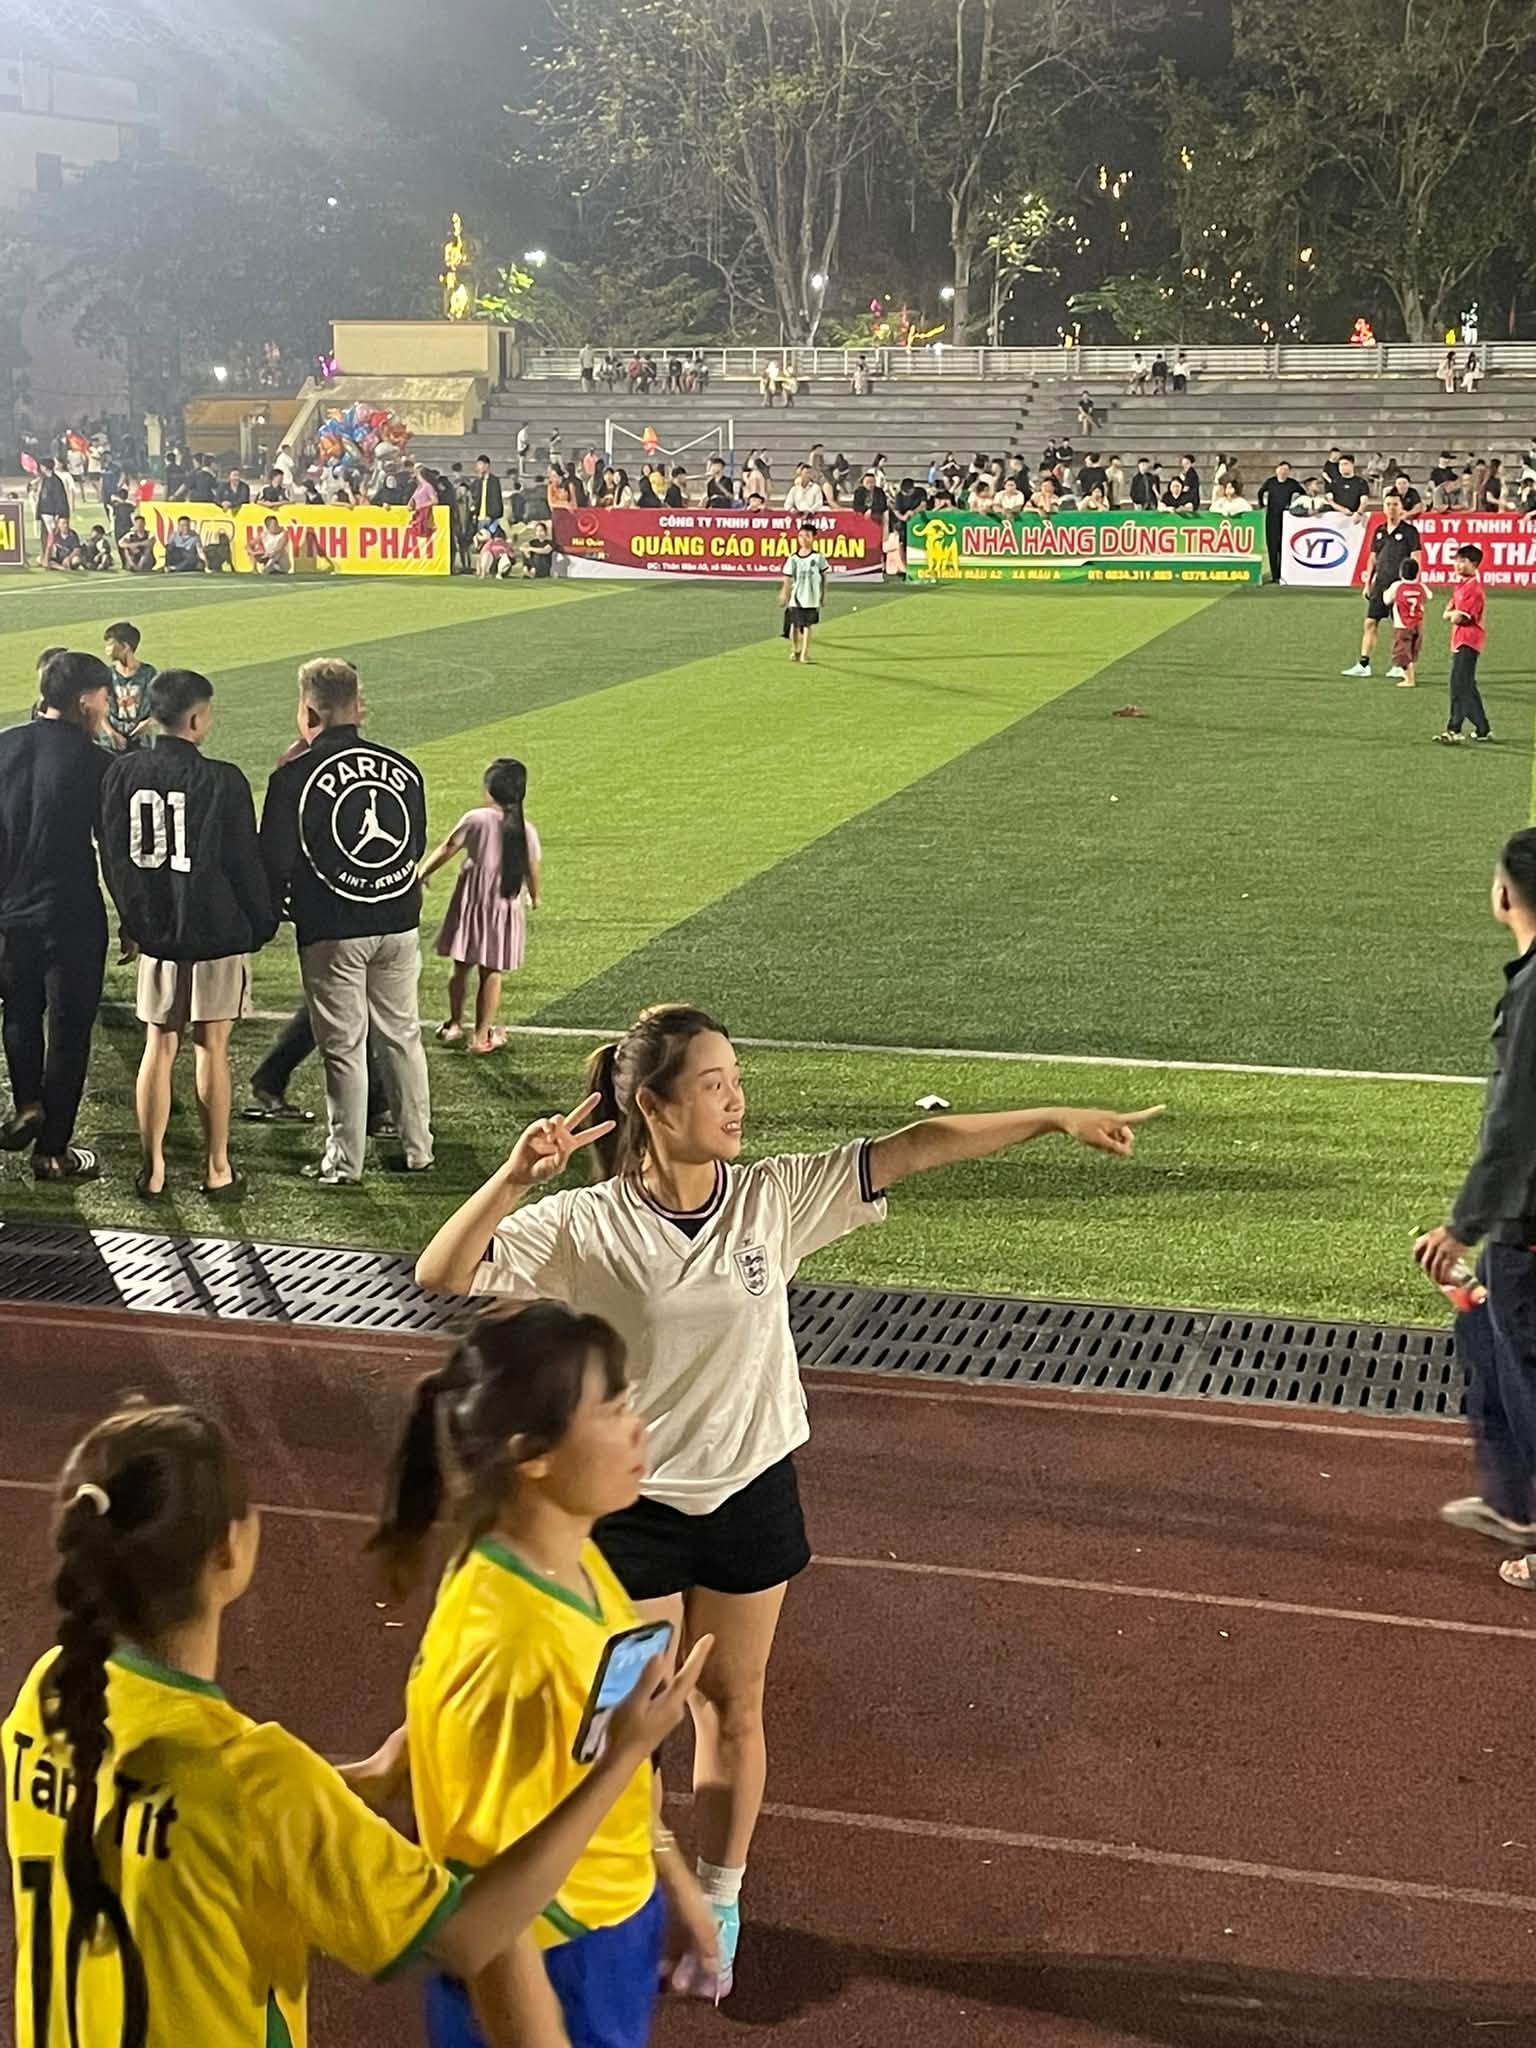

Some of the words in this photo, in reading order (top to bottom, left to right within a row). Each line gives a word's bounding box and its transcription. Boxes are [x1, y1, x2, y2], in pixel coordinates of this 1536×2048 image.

[659, 514, 694, 528] CÔNG
[697, 517, 711, 528] TY
[716, 517, 749, 529] TNHH
[962, 520, 1019, 556] NHÀ
[1022, 520, 1096, 556] HÀNG
[1100, 520, 1177, 556] DŨNG
[1181, 519, 1254, 556] TRÂU
[1441, 519, 1462, 533] TY
[1466, 519, 1513, 534] TNHH
[246, 518, 348, 558] HỲNH
[631, 530, 705, 557] QUẢNG
[710, 534, 755, 557] CÁO
[760, 532, 798, 557] HẢI
[1305, 538, 1335, 558] YT
[316, 756, 409, 799] PARIS
[129, 789, 192, 873] 01
